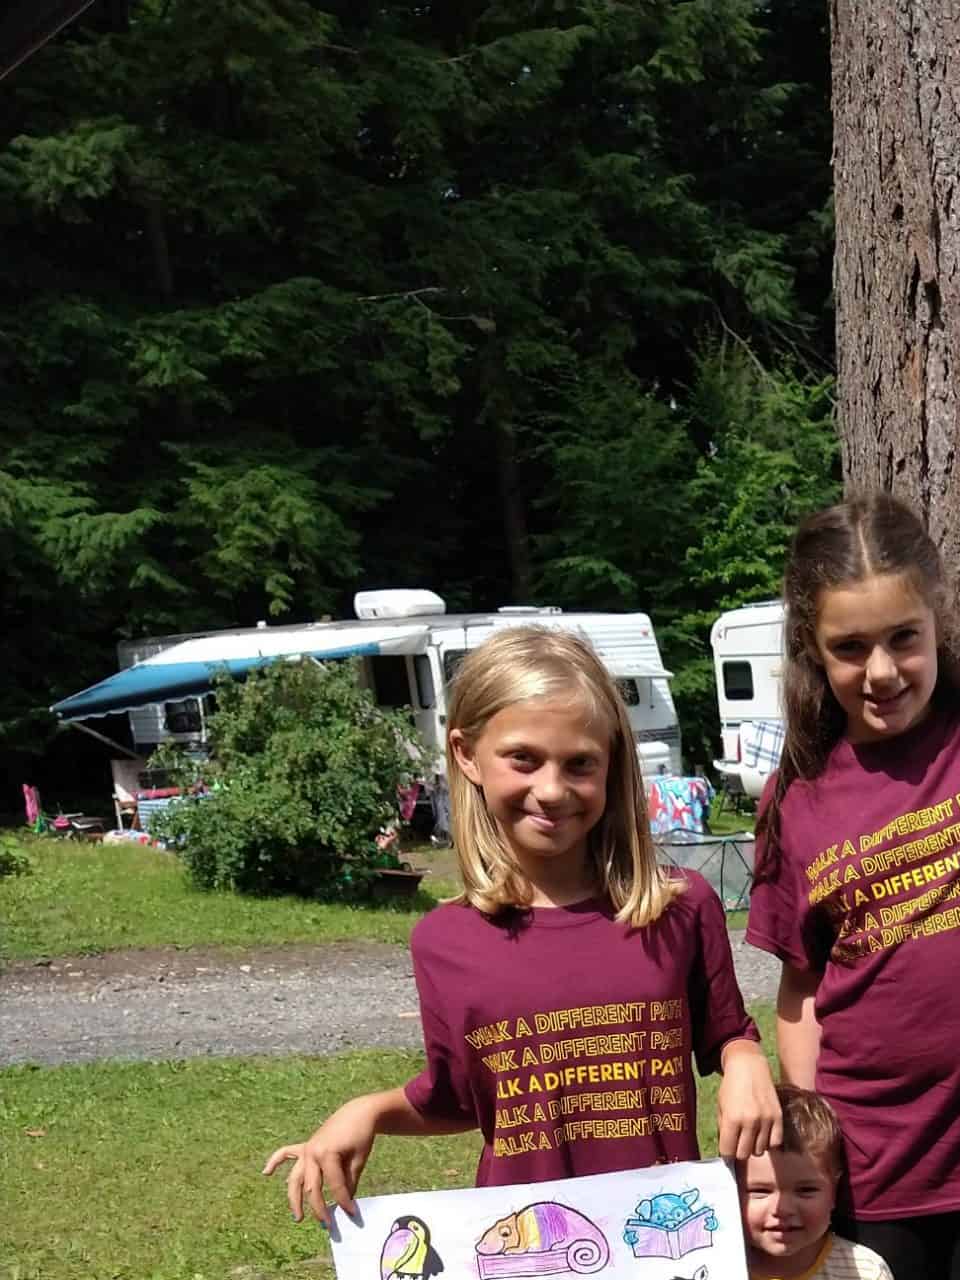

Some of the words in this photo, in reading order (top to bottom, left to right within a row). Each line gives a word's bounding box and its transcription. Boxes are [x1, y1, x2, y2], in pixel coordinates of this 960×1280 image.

[841, 839, 857, 858] A
[844, 863, 861, 883] A
[855, 889, 870, 907] A
[865, 911, 880, 932] A
[868, 934, 884, 953] A
[516, 1017, 533, 1039] A
[535, 1002, 646, 1034] DIFFERENT
[522, 1047, 539, 1067] A
[540, 1031, 646, 1064] DIFFERENT
[497, 1078, 524, 1099] LK
[529, 1075, 543, 1093] A
[544, 1059, 646, 1091] DIFFERENT
[651, 1055, 683, 1077] PATH
[496, 1104, 531, 1129] ALK
[534, 1102, 547, 1122] A
[651, 1084, 682, 1105] PAT
[494, 1131, 538, 1157] ALK
[539, 1131, 553, 1150] A
[650, 1112, 688, 1135] PAT
